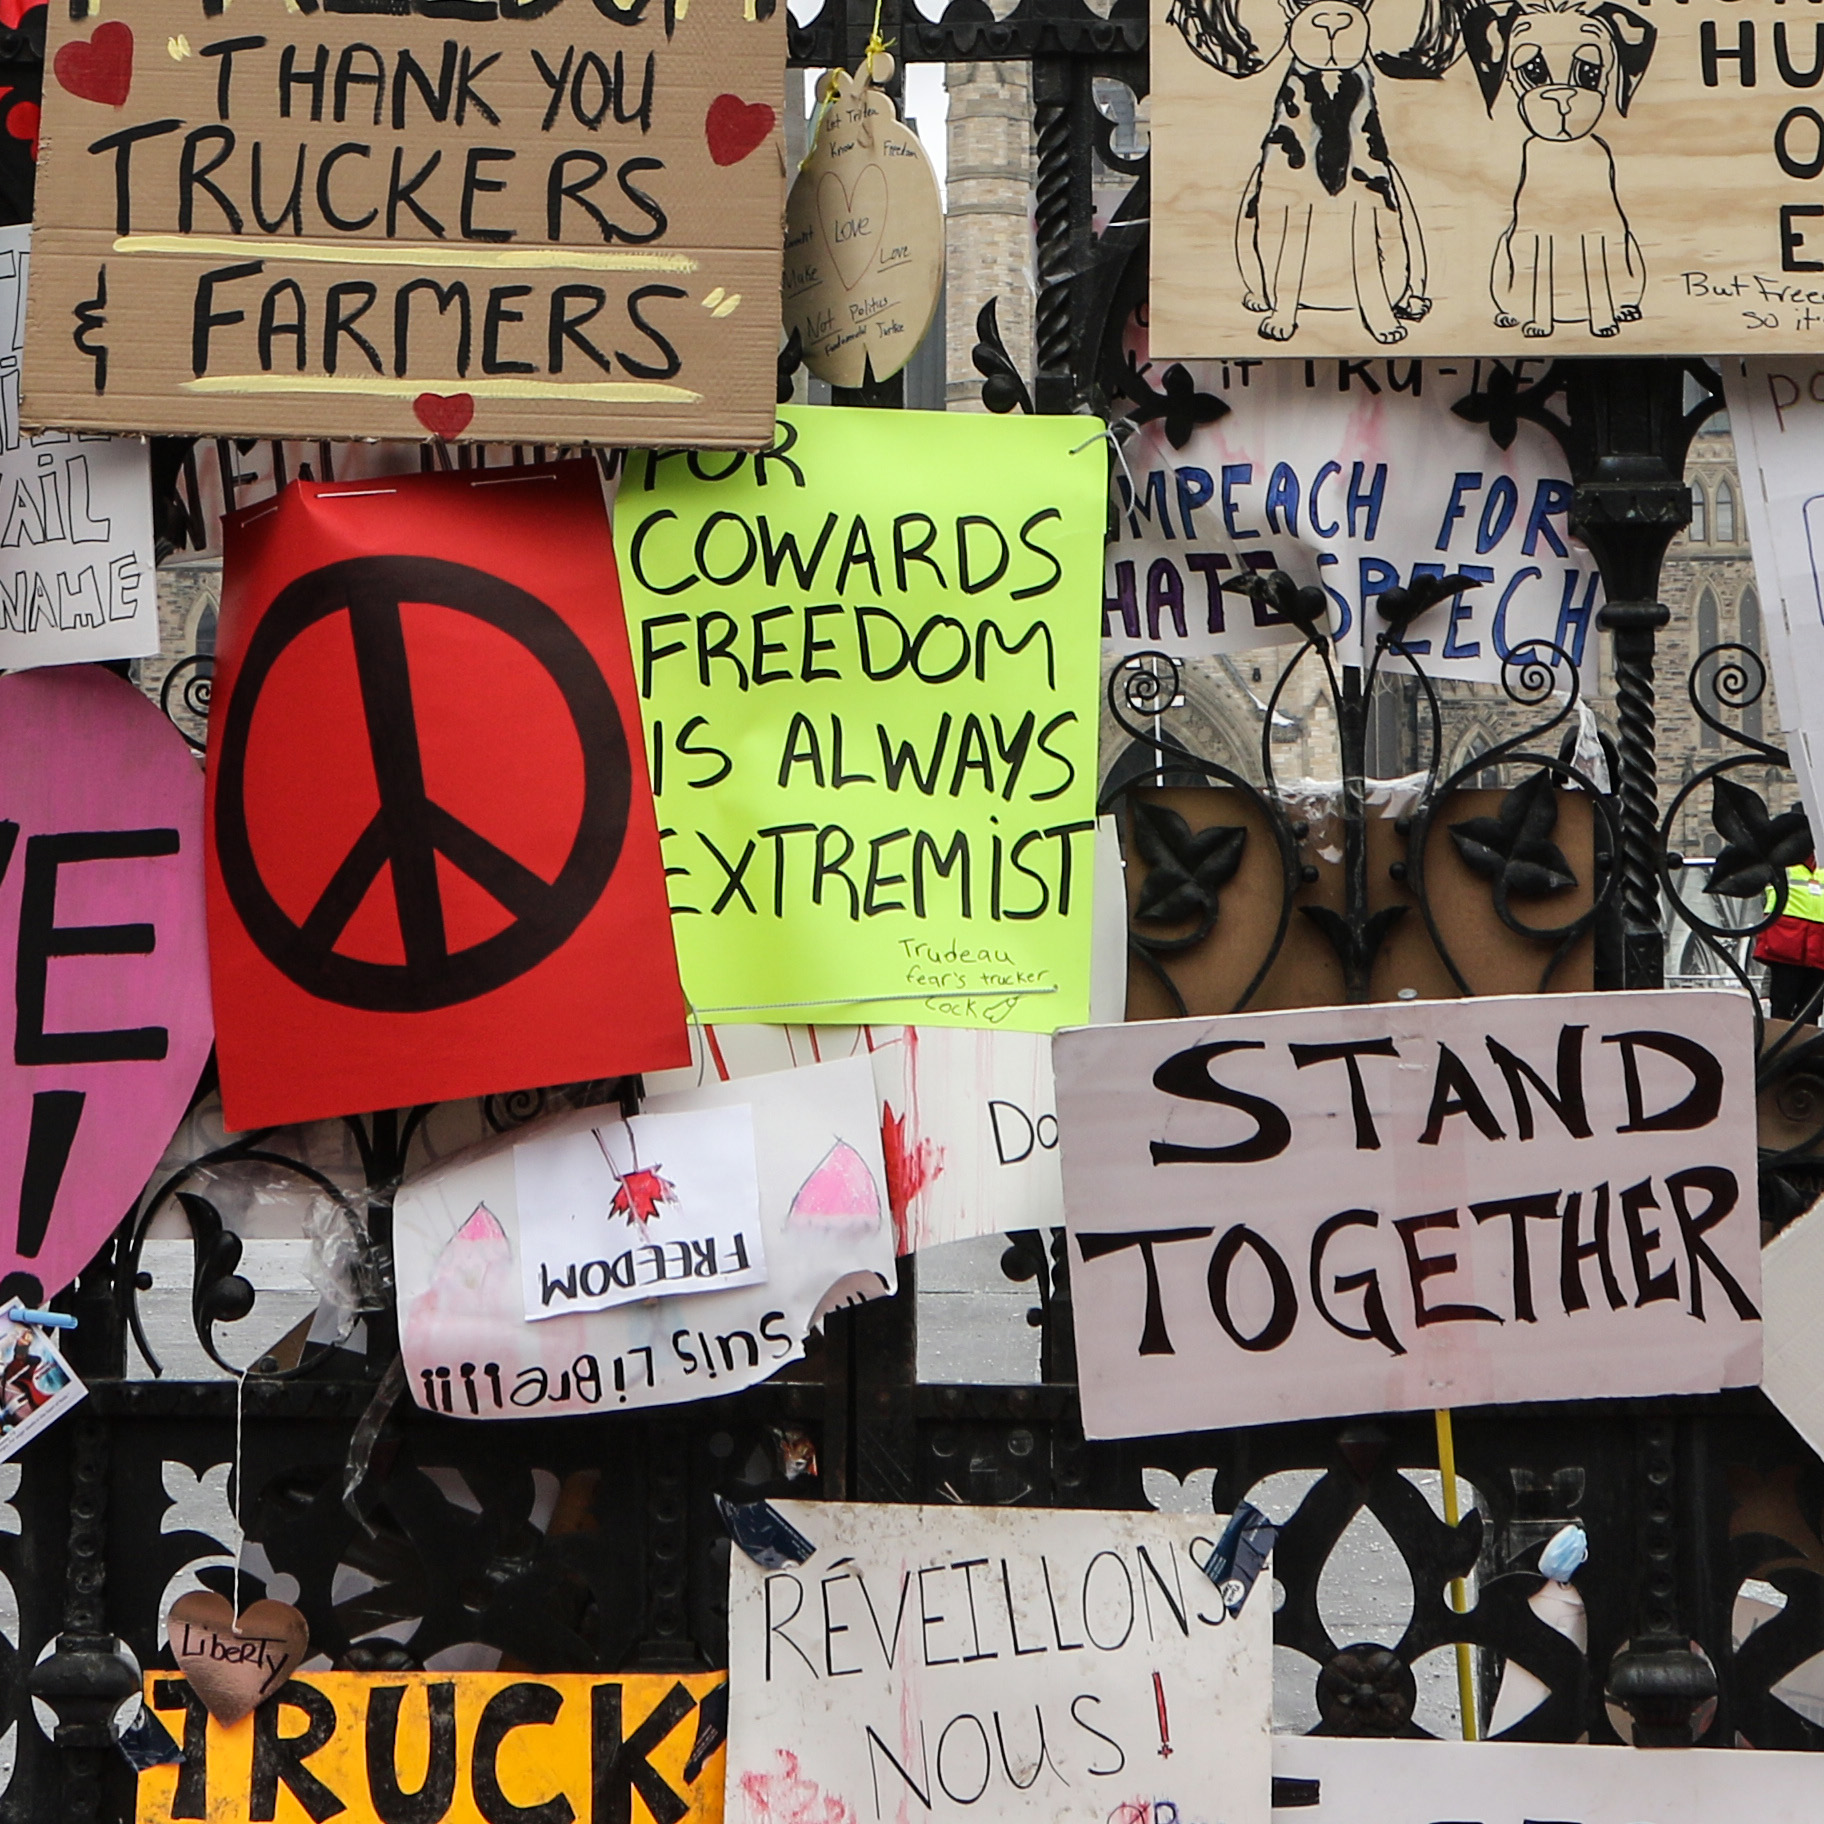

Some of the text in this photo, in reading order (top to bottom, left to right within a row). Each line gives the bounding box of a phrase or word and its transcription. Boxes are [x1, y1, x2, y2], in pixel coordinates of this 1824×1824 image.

[530, 44, 655, 136] YOU
[87, 118, 668, 246] TRUCKERS
[71, 263, 109, 397] &
[1680, 271, 1750, 297] But
[630, 507, 1062, 601] COWARDS
[641, 603, 1056, 700] FREEDOM
[651, 709, 1078, 802] IS ALWAYS
[898, 937, 1015, 966] Trudeau
[979, 969, 1050, 986] trucker
[1149, 1023, 1724, 1167] STAND
[540, 1232, 751, 1307] FREEDOM
[1074, 1165, 1763, 1358] TOGETHER
[864, 1693, 1128, 1822] NOUS
